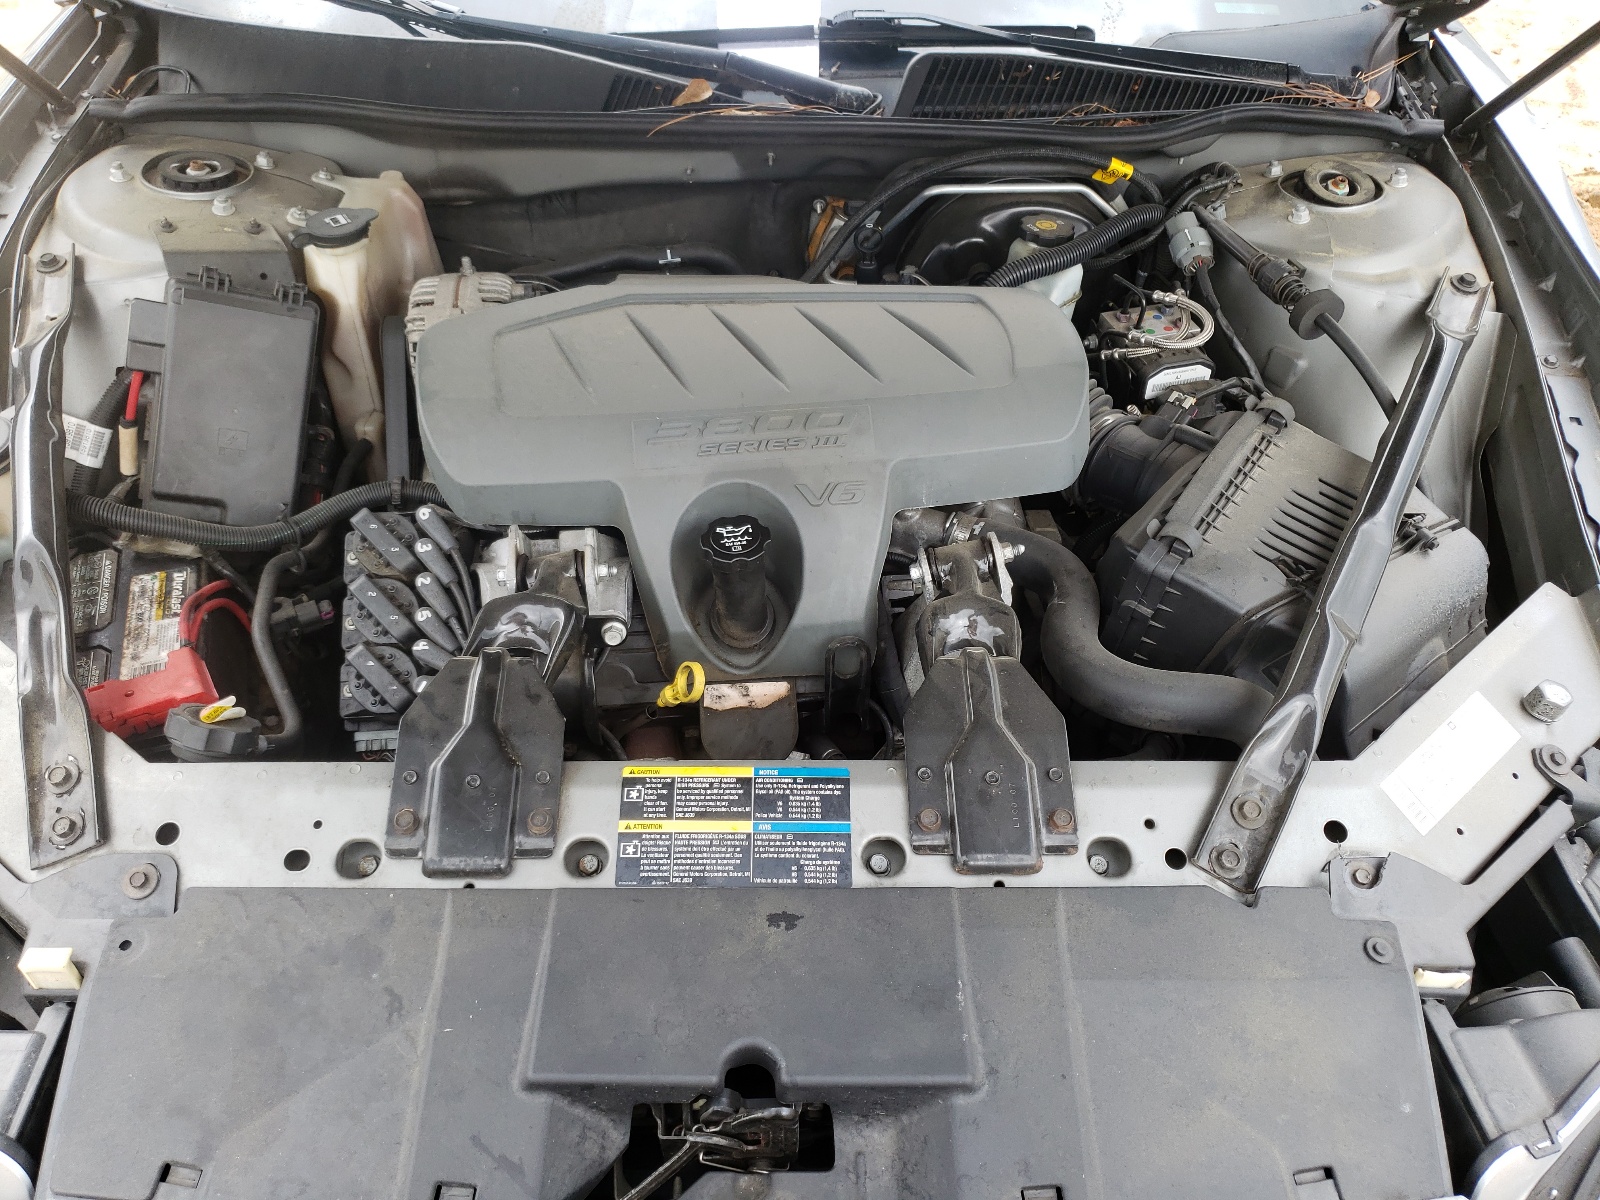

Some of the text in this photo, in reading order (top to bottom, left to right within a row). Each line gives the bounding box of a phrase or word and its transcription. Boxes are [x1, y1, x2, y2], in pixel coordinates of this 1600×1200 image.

[697, 434, 848, 457] SERIES III
[795, 480, 868, 507] V6
[418, 507, 432, 521] 6
[418, 542, 432, 552] 3
[418, 576, 431, 587] 2
[171, 571, 186, 614] Duralast
[100, 592, 108, 614] POISON
[417, 610, 432, 622] 5
[413, 640, 430, 650] 4
